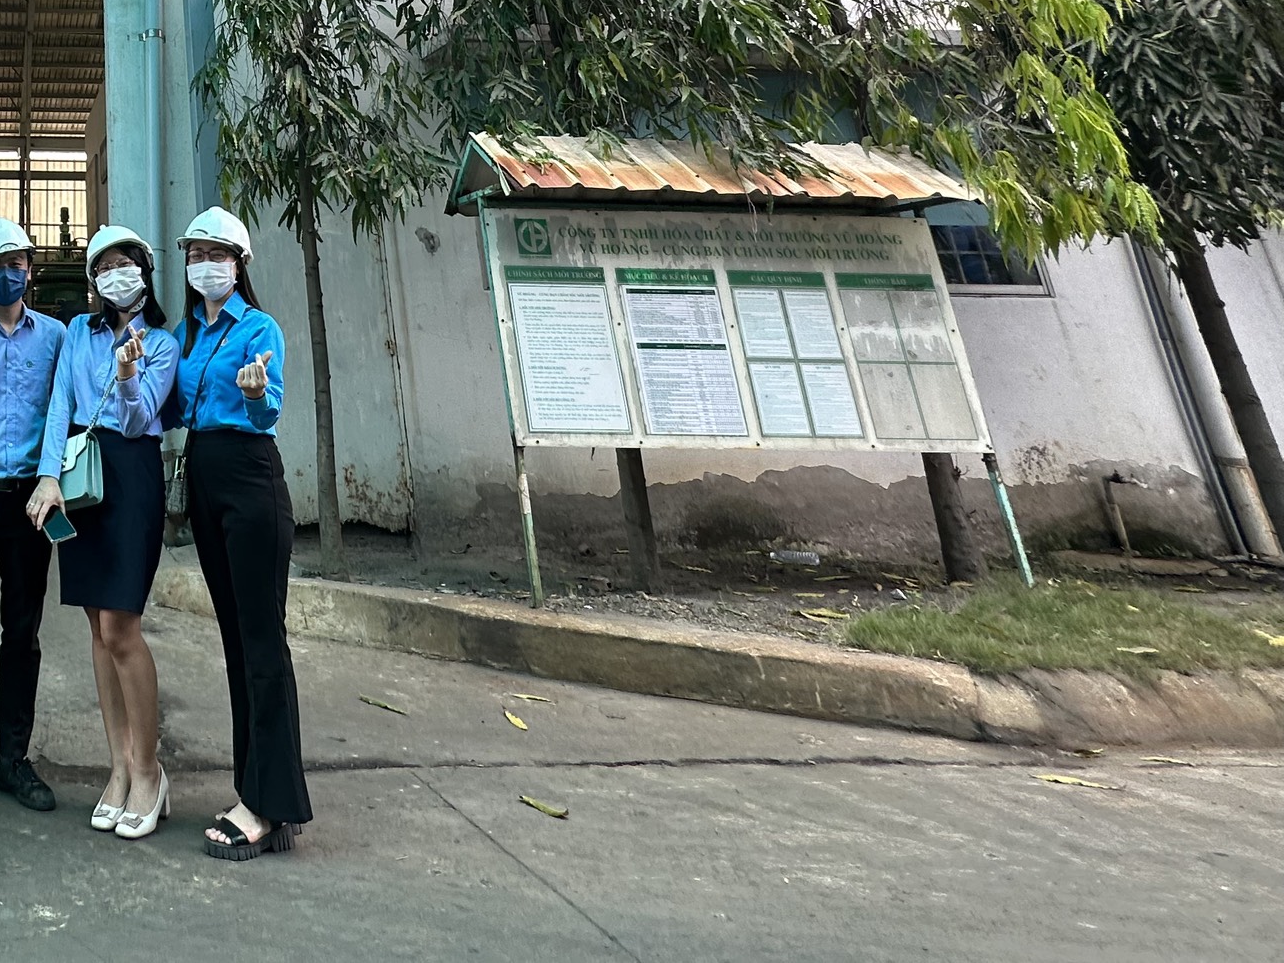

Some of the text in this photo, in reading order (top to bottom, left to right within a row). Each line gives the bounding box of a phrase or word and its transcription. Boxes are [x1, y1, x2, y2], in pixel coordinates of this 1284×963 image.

[559, 225, 596, 239] CÔNG
[599, 229, 616, 239] TY
[620, 228, 659, 239] TNHH
[695, 225, 732, 241] CHẤT
[735, 230, 745, 241] &
[747, 229, 774, 243] MÔI
[833, 231, 852, 245] VŨ
[855, 230, 903, 245] HOÀNG
[579, 241, 598, 255] VŨ
[601, 241, 649, 255] HOÀNG
[662, 242, 701, 256] CÙNG
[703, 245, 734, 259] BẠN
[775, 245, 802, 259] SÓC
[803, 246, 832, 260] MÔI
[533, 268, 553, 278] SÁCH
